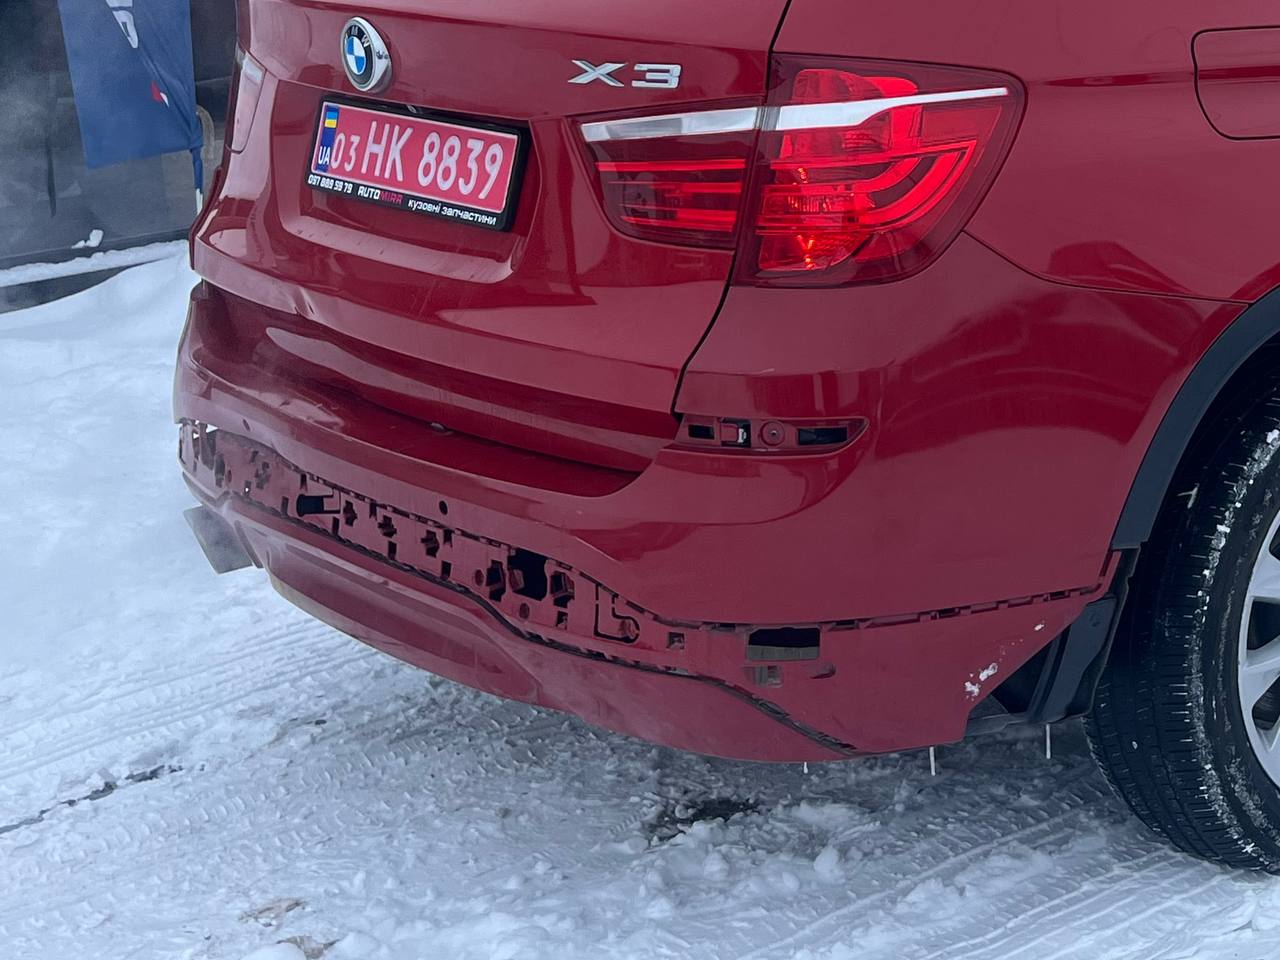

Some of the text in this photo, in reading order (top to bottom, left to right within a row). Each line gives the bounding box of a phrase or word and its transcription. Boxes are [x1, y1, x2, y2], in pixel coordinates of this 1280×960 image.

[318, 146, 331, 165] UA
[418, 131, 503, 200] 8839
[408, 199, 497, 226] кузовні запчастини
